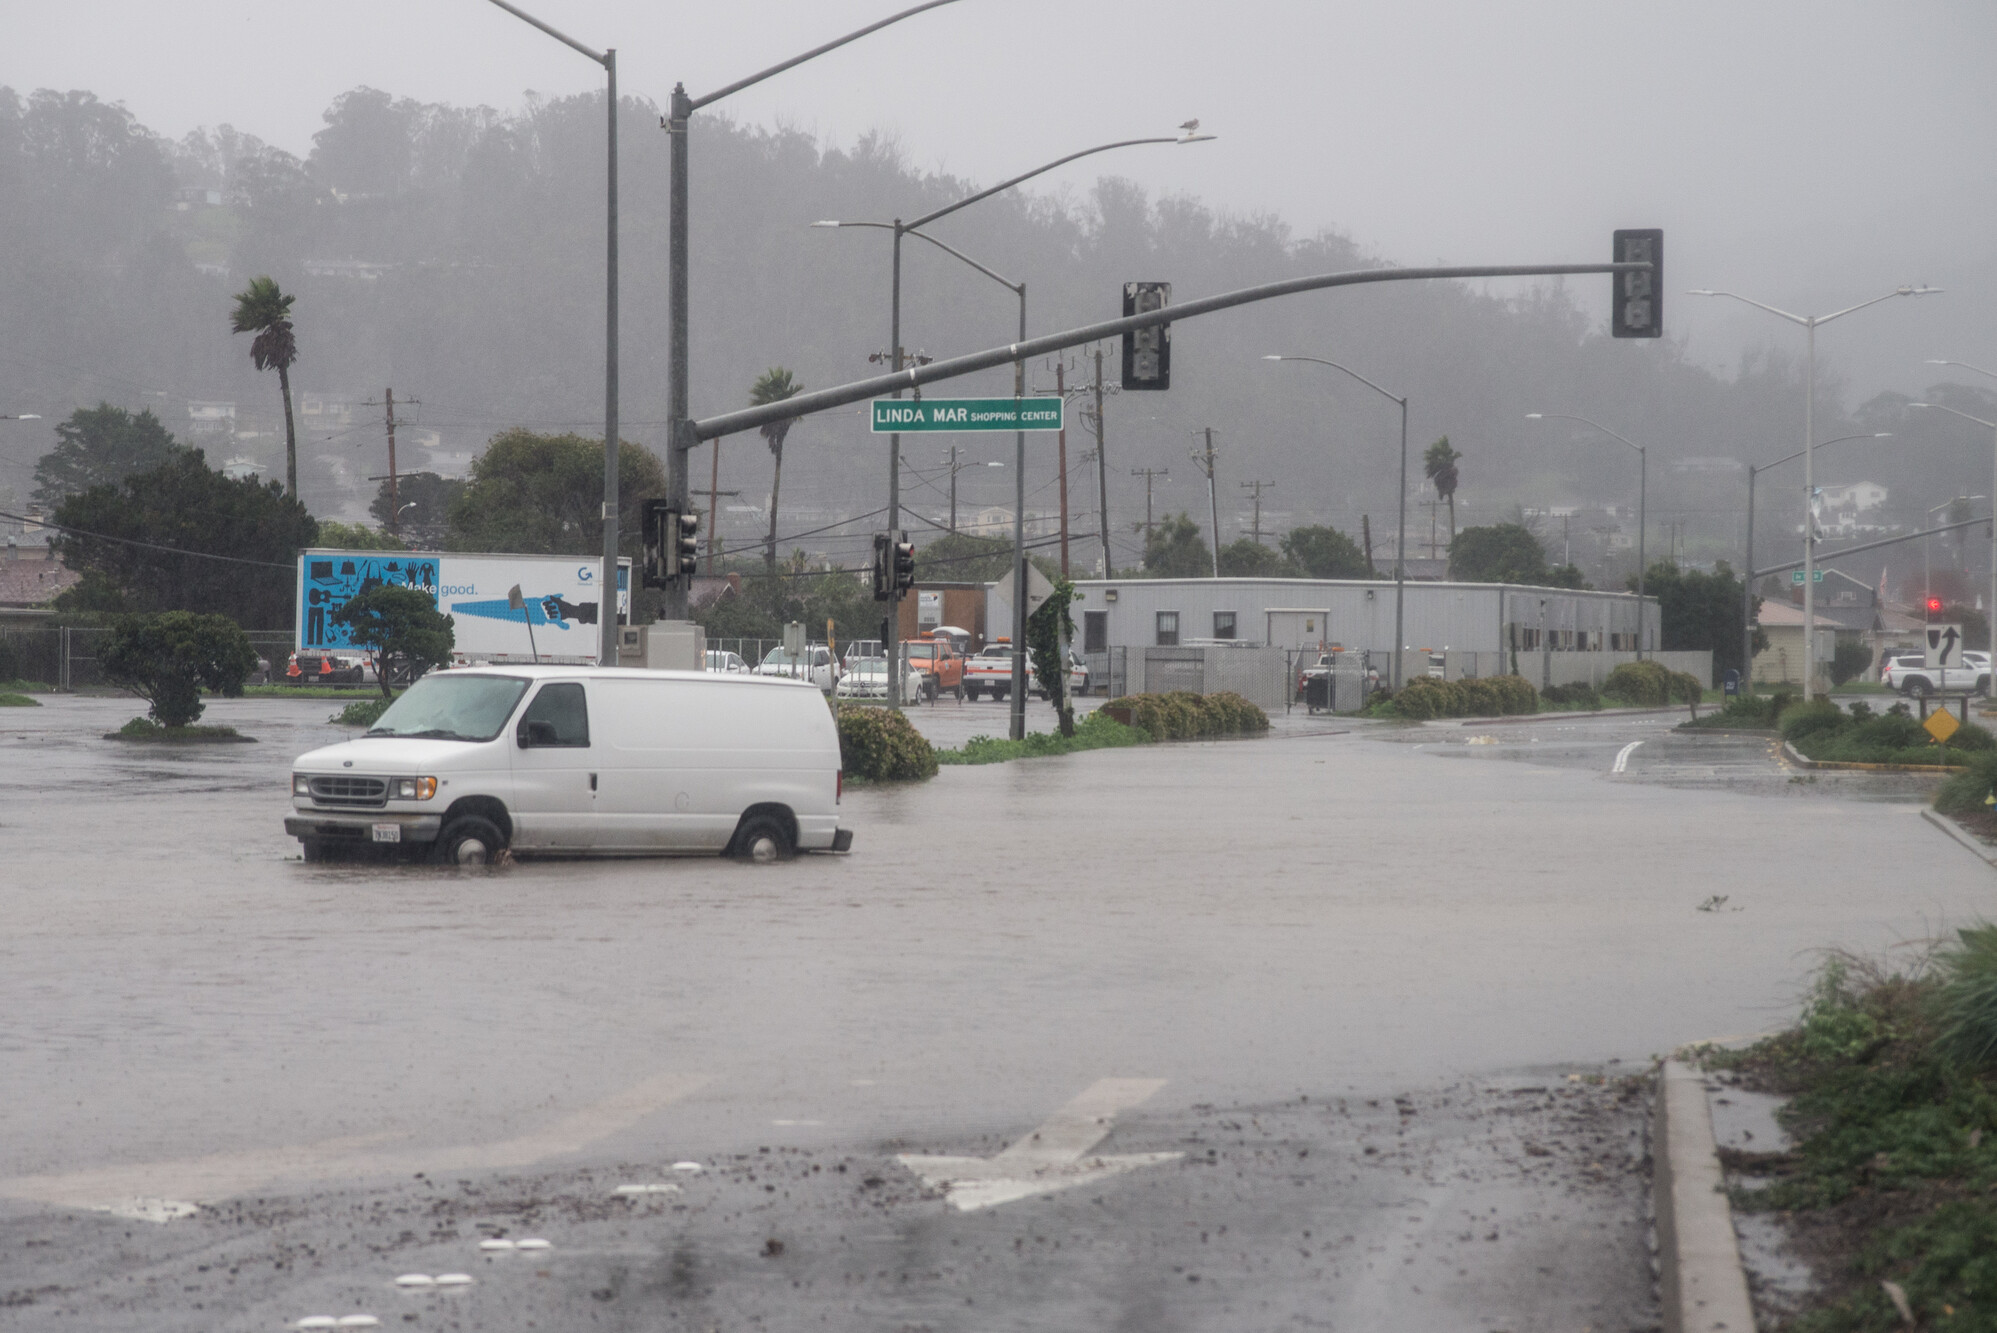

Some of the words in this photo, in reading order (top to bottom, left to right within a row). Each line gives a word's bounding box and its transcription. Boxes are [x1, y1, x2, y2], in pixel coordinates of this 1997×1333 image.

[877, 408, 925, 423] LINDA
[933, 408, 968, 422] MAR
[971, 412, 1017, 421] SHOPPING
[1021, 411, 1057, 421] CENTER
[440, 583, 479, 597] good.
